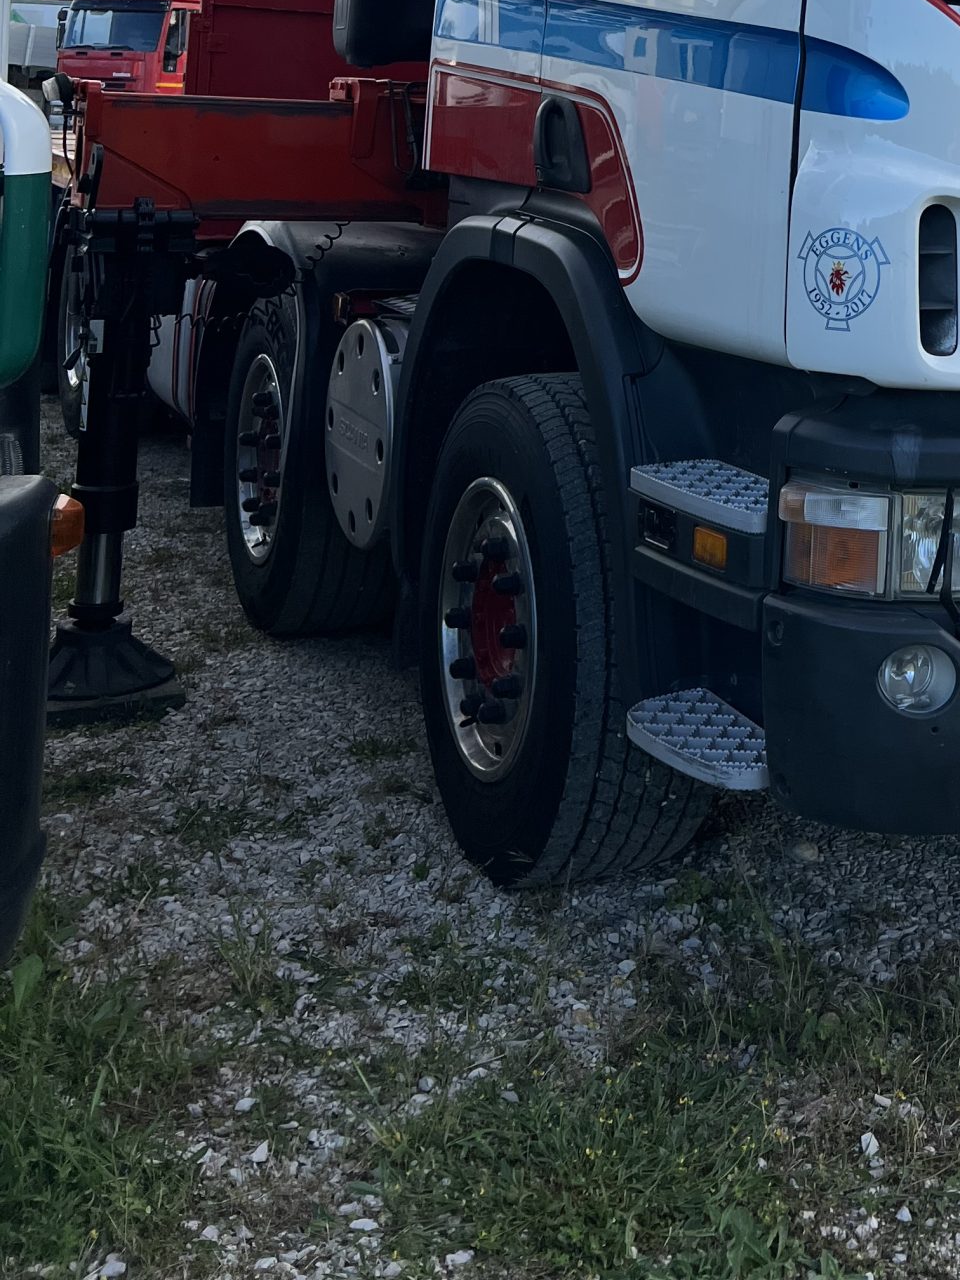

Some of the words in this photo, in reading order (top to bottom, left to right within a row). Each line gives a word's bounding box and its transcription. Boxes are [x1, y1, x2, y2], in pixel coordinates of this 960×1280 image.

[810, 230, 873, 261] EGGENS
[809, 286, 832, 316] 1952
[844, 290, 872, 317] 2017
